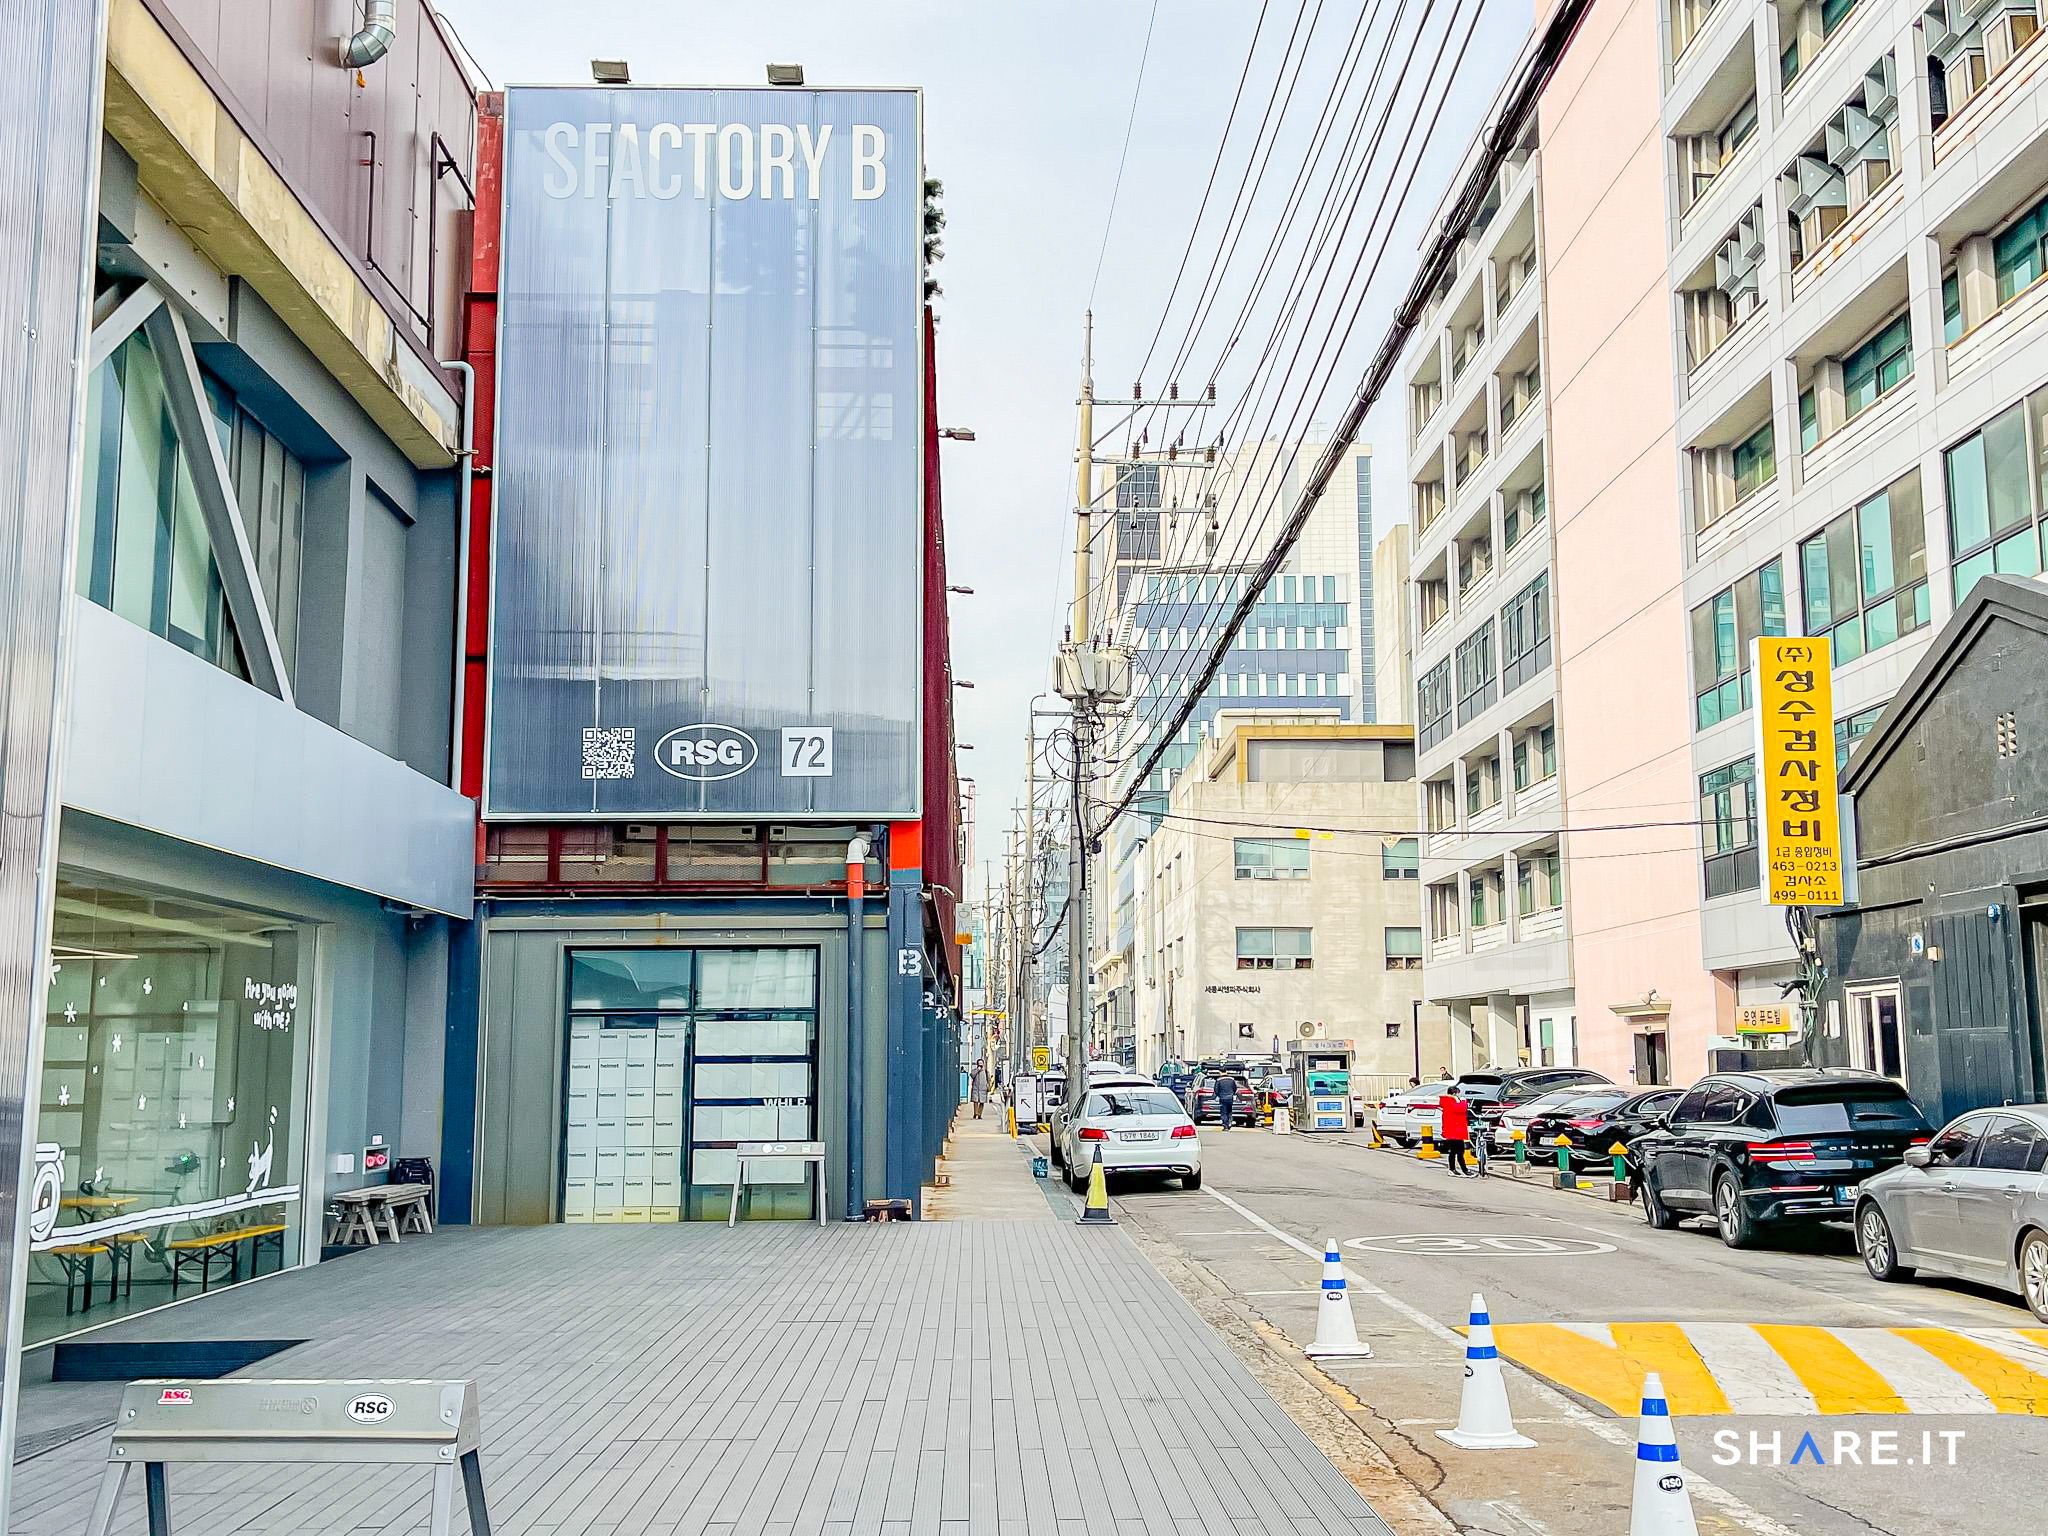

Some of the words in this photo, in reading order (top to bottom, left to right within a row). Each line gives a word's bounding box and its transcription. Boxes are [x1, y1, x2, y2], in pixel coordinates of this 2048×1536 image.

[543, 121, 833, 200] SFACTORY
[852, 124, 887, 200] B
[1777, 646, 1812, 662] (주)
[671, 739, 742, 766] RSG
[788, 737, 825, 768] 72
[1776, 671, 1822, 841] 성수검사정비
[1776, 847, 1790, 857] 1급
[1772, 861, 1837, 872] 463-0213
[1783, 875, 1827, 887] 검사소
[1773, 890, 1839, 901] 499-0111
[245, 977, 261, 999] Are
[259, 983, 276, 1005] you
[275, 983, 297, 1009] going
[253, 1010, 272, 1029] with
[1744, 1009, 1757, 1026] 우영
[164, 1390, 190, 1399] RSG
[354, 1401, 388, 1414] RSG
